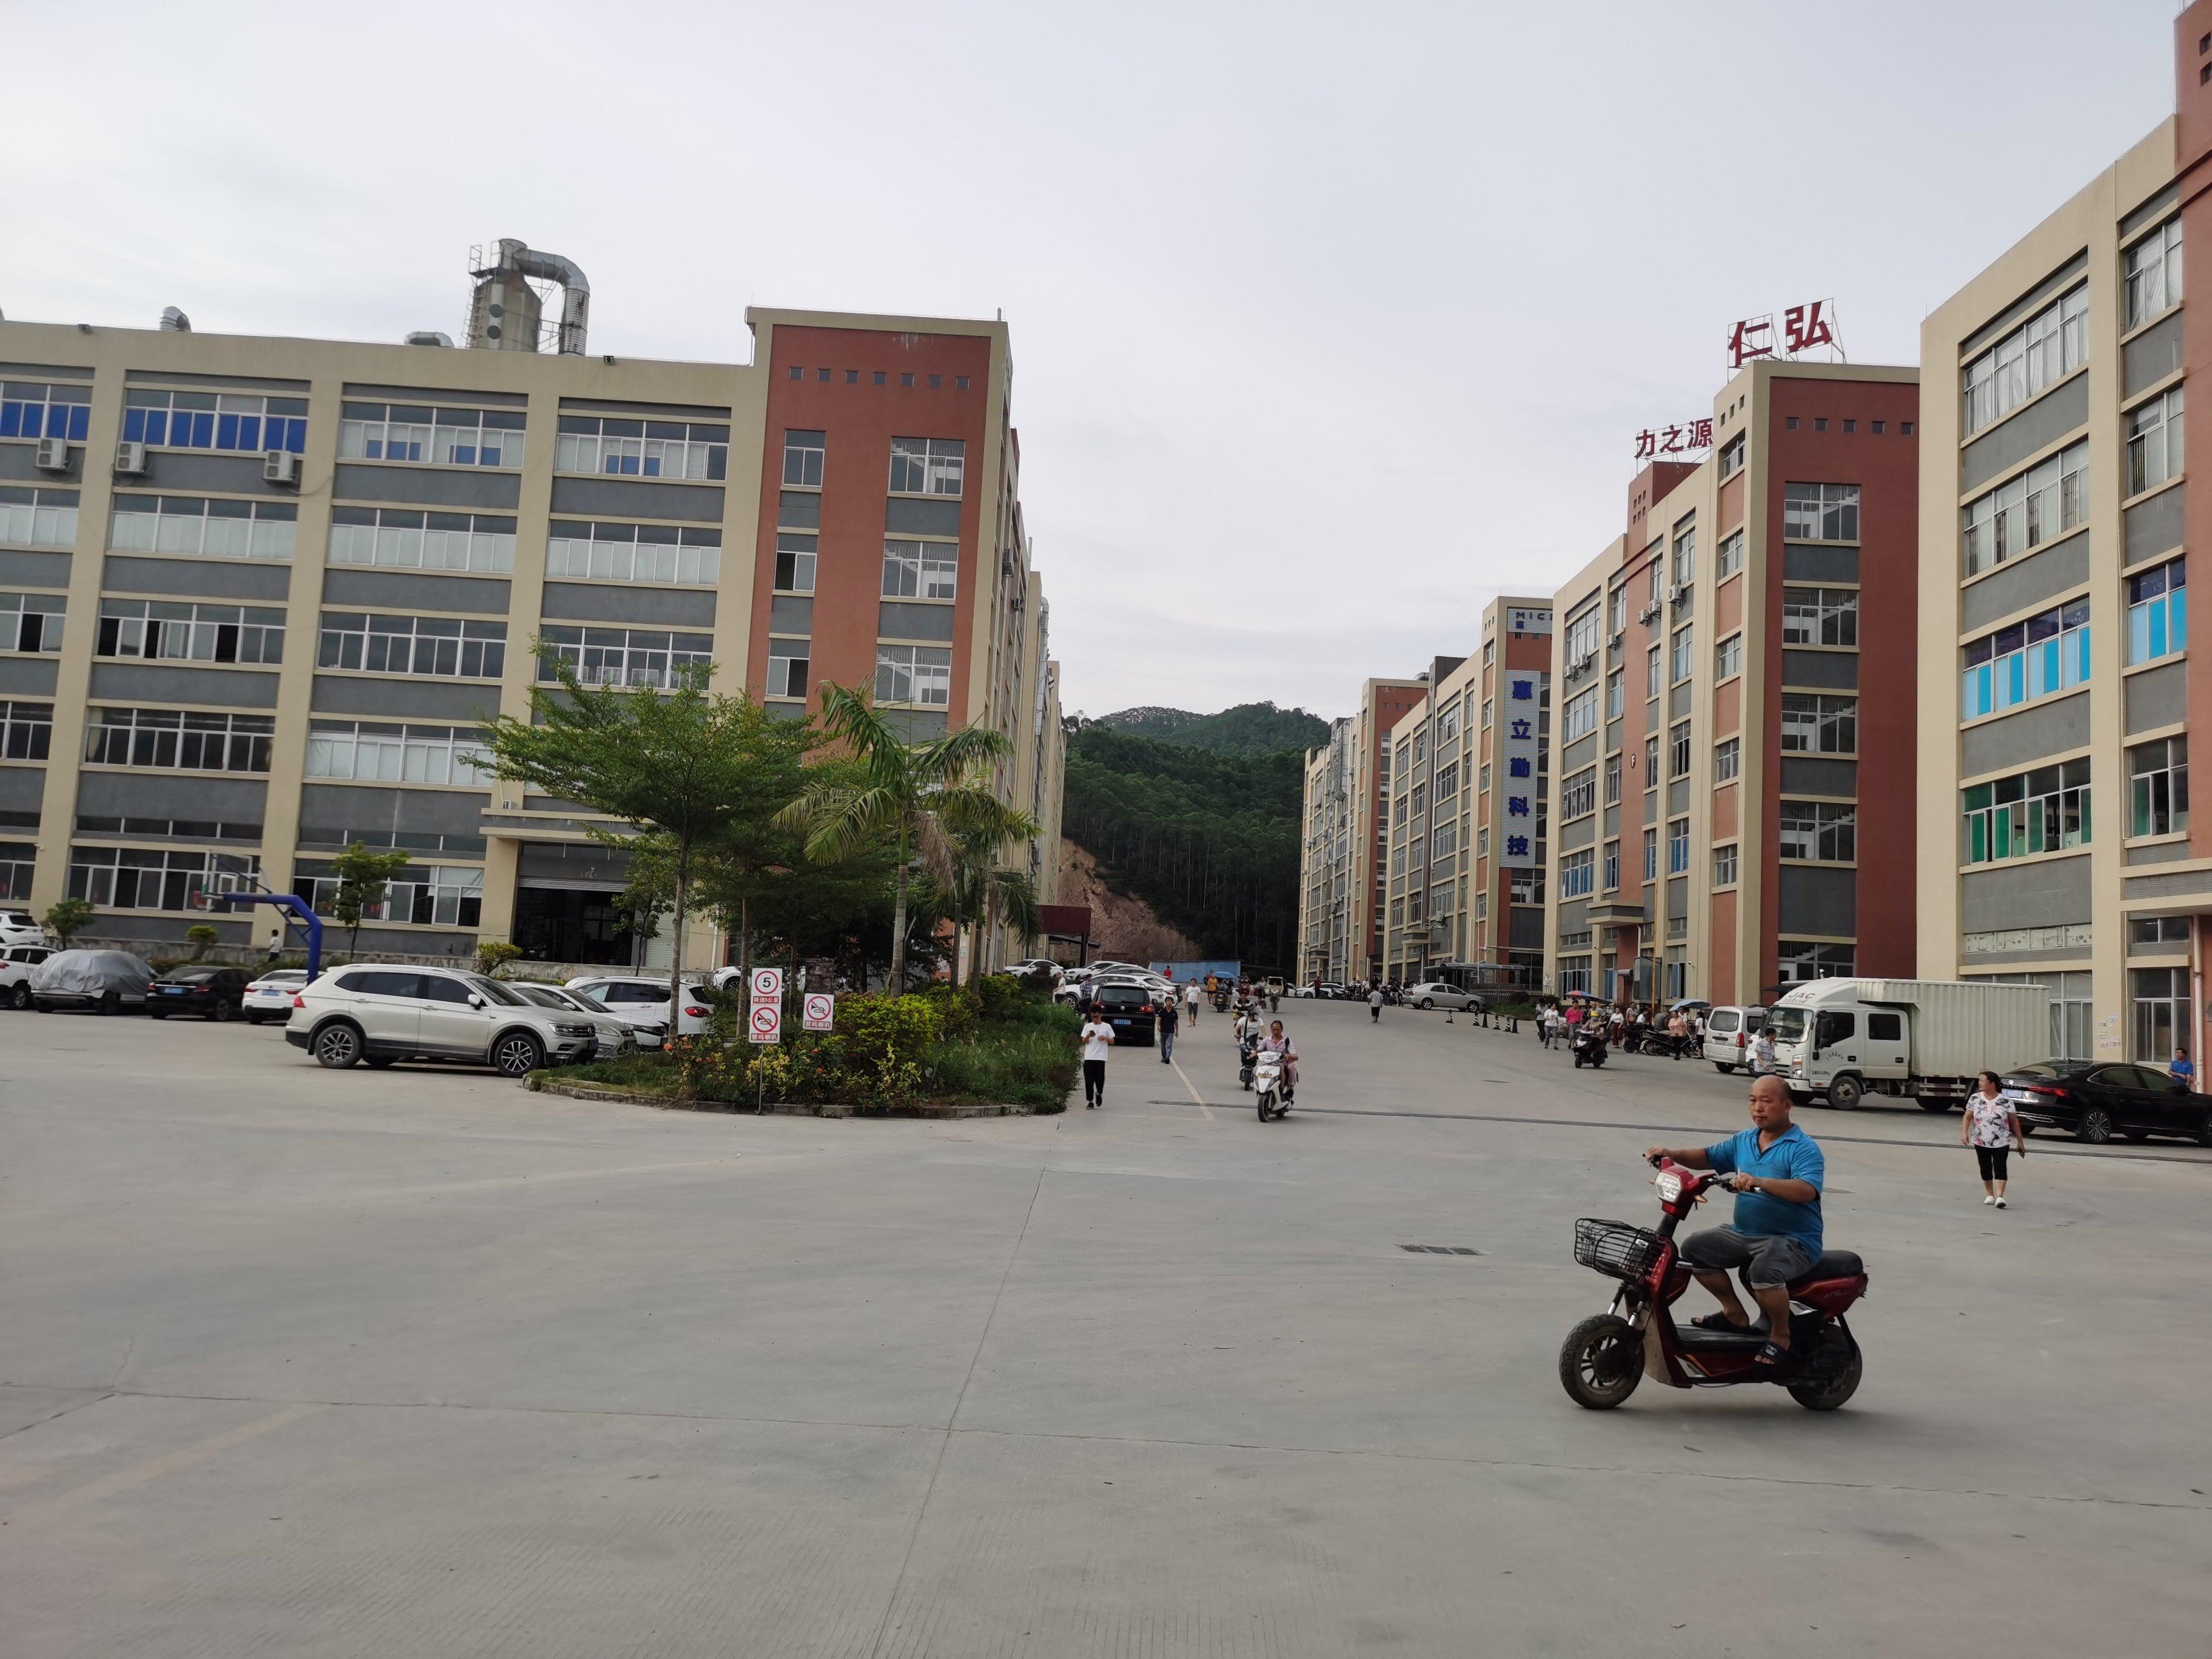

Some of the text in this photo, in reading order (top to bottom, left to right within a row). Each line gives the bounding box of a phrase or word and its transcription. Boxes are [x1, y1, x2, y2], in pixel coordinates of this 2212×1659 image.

[1728, 302, 1832, 367] 仁弘
[1635, 418, 1713, 459] 力之源
[763, 977, 771, 987] 5
[805, 1021, 831, 1029] 禁鸣喇叭
